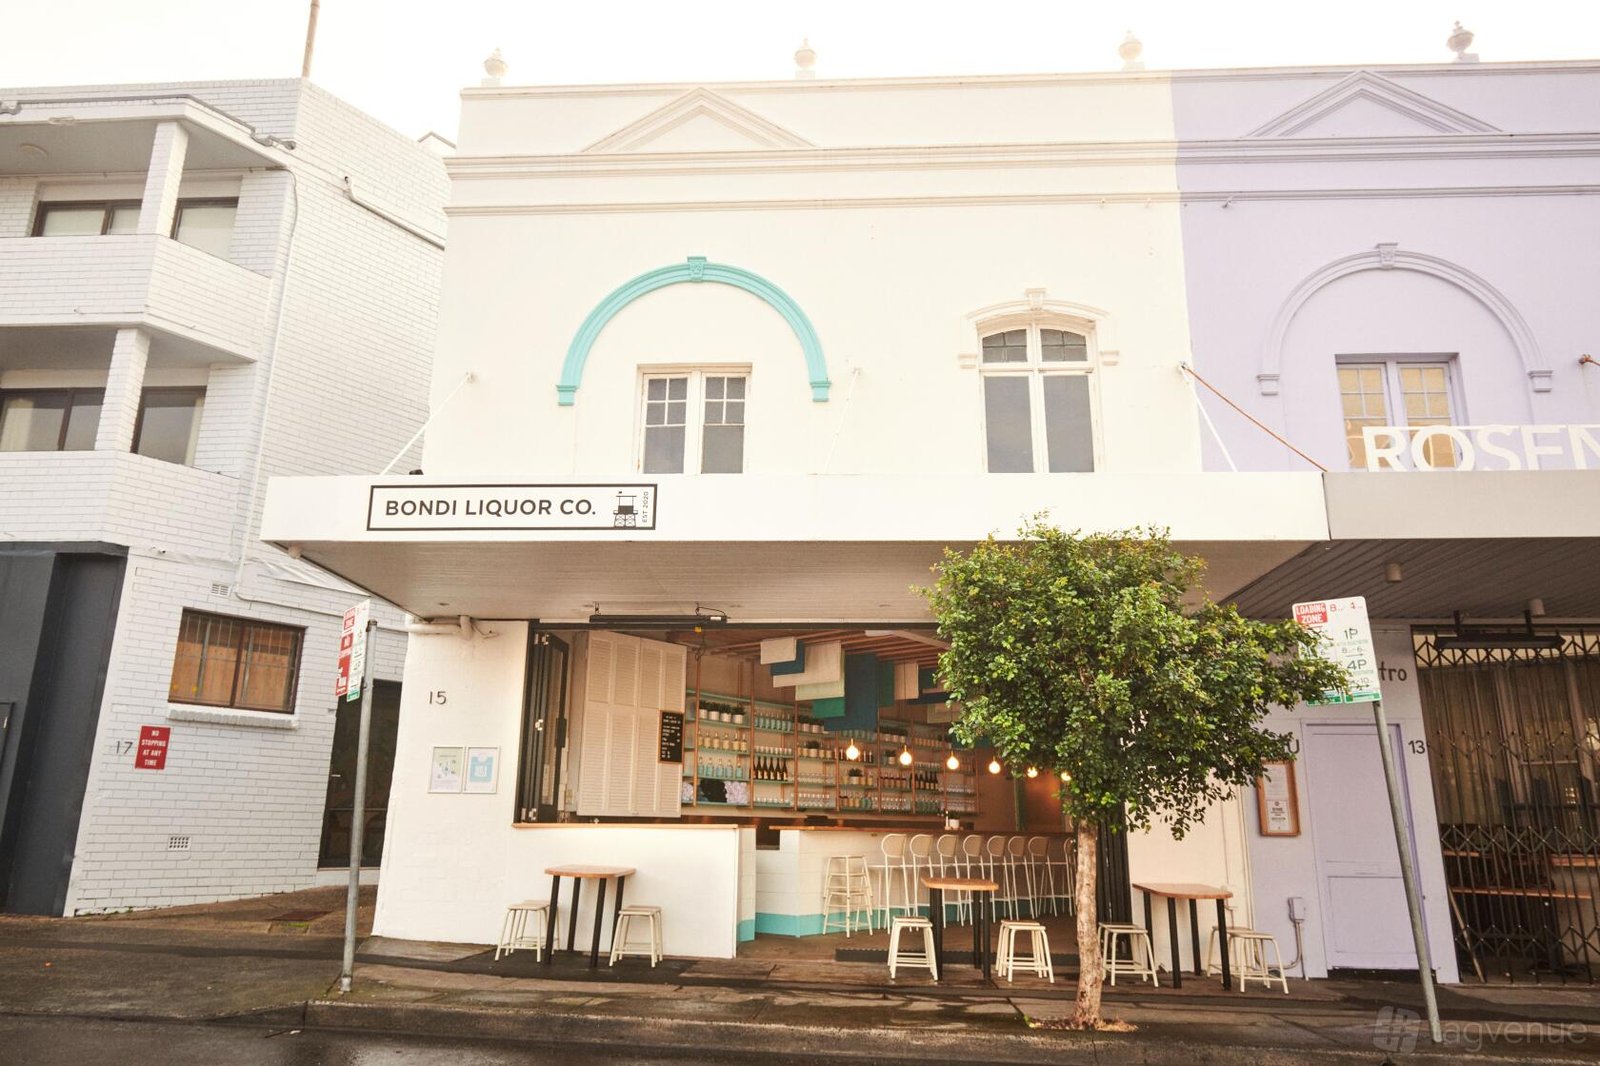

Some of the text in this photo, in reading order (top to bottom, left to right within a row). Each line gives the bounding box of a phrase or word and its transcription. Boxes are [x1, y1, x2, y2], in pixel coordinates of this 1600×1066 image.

[385, 498, 597, 518] BONDI LIQUOR CO.
[1296, 603, 1326, 614] LOADING
[1301, 613, 1324, 623] ZONE
[1347, 659, 1367, 671] 4P
[1378, 661, 1408, 682] tro
[429, 690, 447, 705] 15
[115, 740, 134, 754] 17
[141, 739, 167, 747] STOPPING
[1408, 739, 1426, 754] 13
[144, 759, 157, 767] TIME
